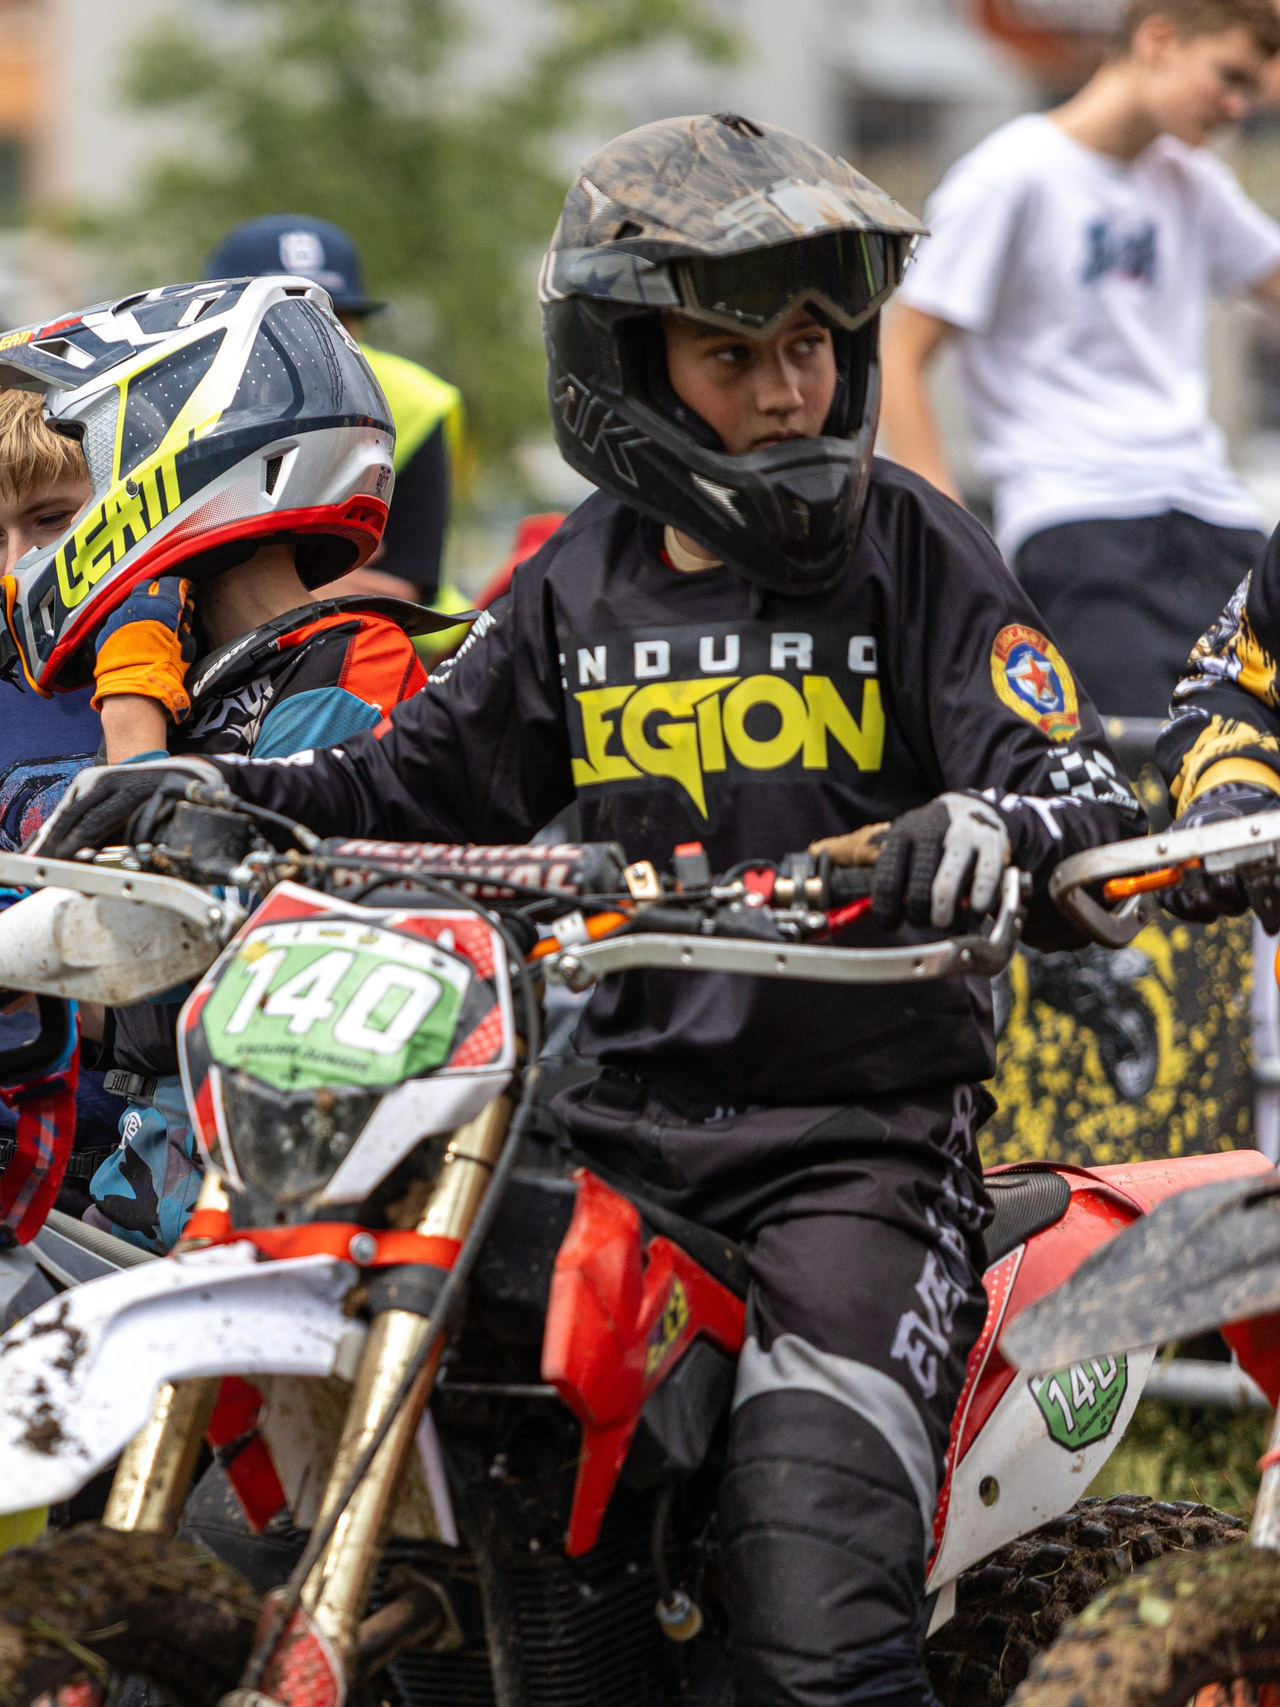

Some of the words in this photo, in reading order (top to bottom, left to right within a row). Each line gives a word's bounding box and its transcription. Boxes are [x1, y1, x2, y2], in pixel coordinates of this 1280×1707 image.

[55, 452, 182, 608] LEATT
[193, 633, 258, 698] LEATT
[558, 632, 878, 690] NDURO
[222, 947, 444, 1056] 140
